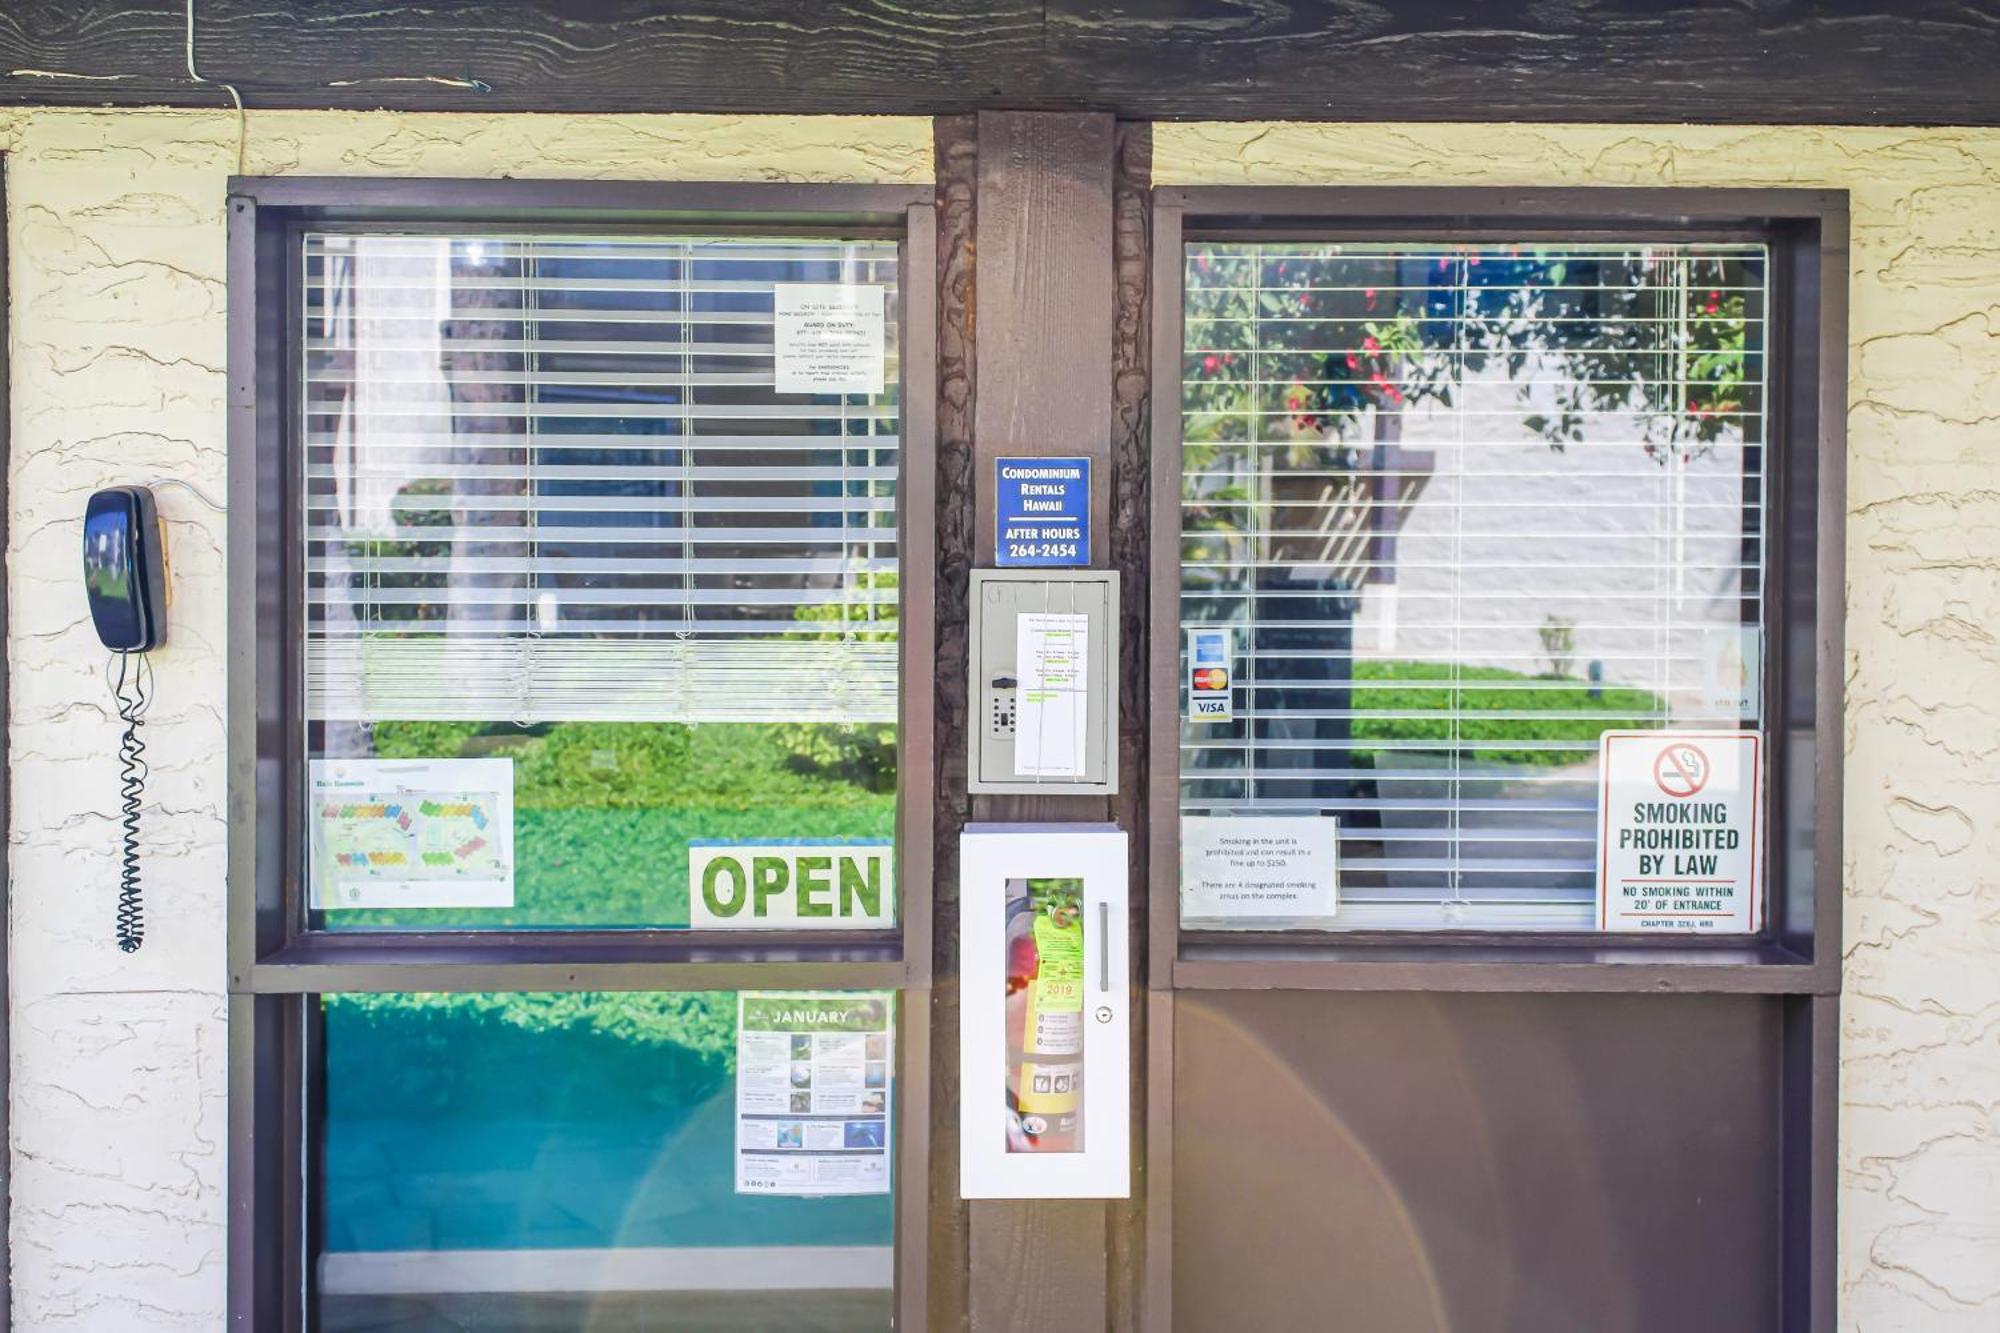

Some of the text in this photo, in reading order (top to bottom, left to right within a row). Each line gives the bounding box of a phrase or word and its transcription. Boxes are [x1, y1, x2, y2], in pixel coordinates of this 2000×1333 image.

[1020, 484, 1065, 495] RENTALS
[1024, 500, 1062, 511] HAWAII
[1006, 528, 1080, 539] AFTER HOURS
[1010, 544, 1077, 557] 264-2454
[1198, 703, 1226, 713] VISA
[1634, 802, 1728, 824] SMOKING
[1219, 838, 1251, 846] Smoking
[1620, 828, 1739, 850] PROHIBITED
[1206, 849, 1244, 857] prohibited
[1640, 855, 1718, 876] BY LAW
[702, 856, 881, 918] OPEN
[1202, 881, 1223, 889] There
[1244, 881, 1284, 890] designated
[1287, 881, 1316, 890] smoking
[1252, 892, 1264, 900] the
[1623, 887, 1734, 897] NO SMOKING WITHIN
[1634, 900, 1722, 910] 20' OF ENTRANCE
[1641, 920, 1674, 928] CHAPTER
[1047, 984, 1073, 995] 2019
[773, 1010, 848, 1023] JANUARY
